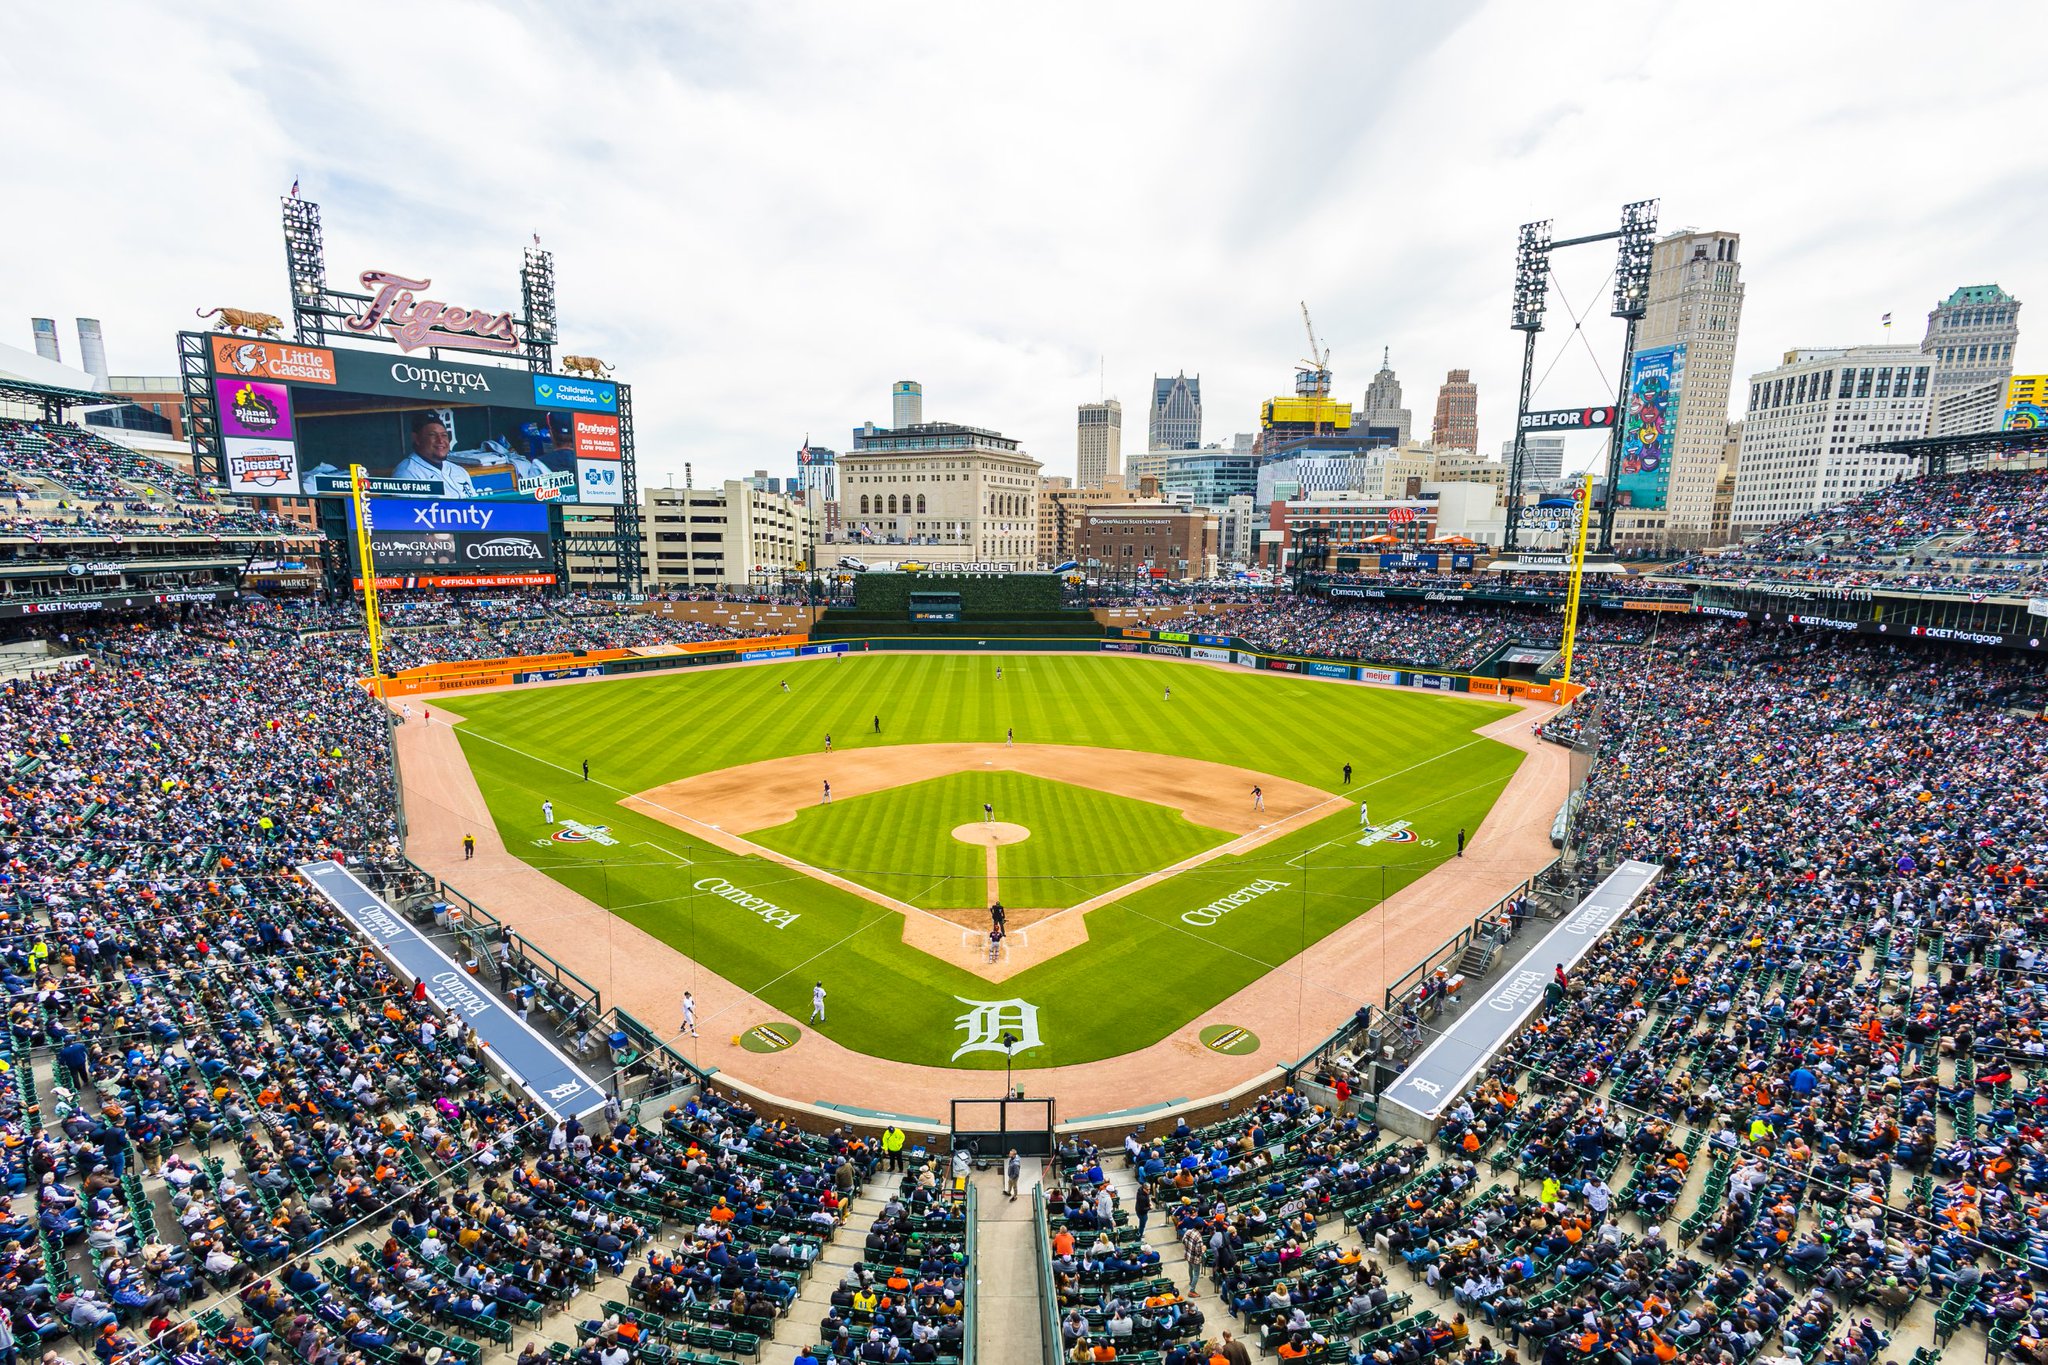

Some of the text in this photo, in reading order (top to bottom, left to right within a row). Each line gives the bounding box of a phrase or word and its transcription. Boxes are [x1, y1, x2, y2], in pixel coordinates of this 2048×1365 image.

[344, 270, 520, 353] Tigers
[280, 348, 323, 366] Little
[269, 359, 330, 379] Caesars
[391, 363, 491, 391] Comerica
[421, 383, 466, 394] PARK
[558, 385, 594, 395] Children's
[556, 392, 597, 403] Foundation
[236, 408, 268, 417] planet
[241, 414, 276, 424] fitness
[1521, 413, 1581, 427] BELFOR
[578, 422, 616, 434] Dunham's
[232, 456, 292, 475] BIGGEST
[520, 479, 542, 491] HALL
[550, 474, 574, 488] FAME
[535, 487, 559, 500] Cam
[413, 503, 493, 529] xfinity
[1389, 508, 1414, 523] AAA
[410, 542, 452, 550] GRAND
[466, 544, 544, 559] Comerica
[1402, 552, 1418, 561] Lite
[1518, 555, 1534, 564] Lite
[86, 562, 125, 571] Gallagher
[932, 562, 1017, 572] CHEVROLET
[280, 579, 310, 587] MARKET
[155, 593, 185, 602] ROCKET
[1331, 588, 1385, 598] Comerica Bank
[1425, 592, 1447, 602] Bally
[22, 602, 102, 613] ROCKET Mortgage
[1719, 608, 1748, 618] Mortgage
[1788, 615, 1857, 630] ROCKET Mortgage
[1911, 626, 2002, 644] ROCKET Mortgage
[1366, 671, 1391, 681] meijer
[693, 877, 801, 930] Comerica
[1181, 878, 1292, 927] Comerica
[432, 972, 491, 1017] Comerica
[1489, 970, 1546, 1011] Comerica
